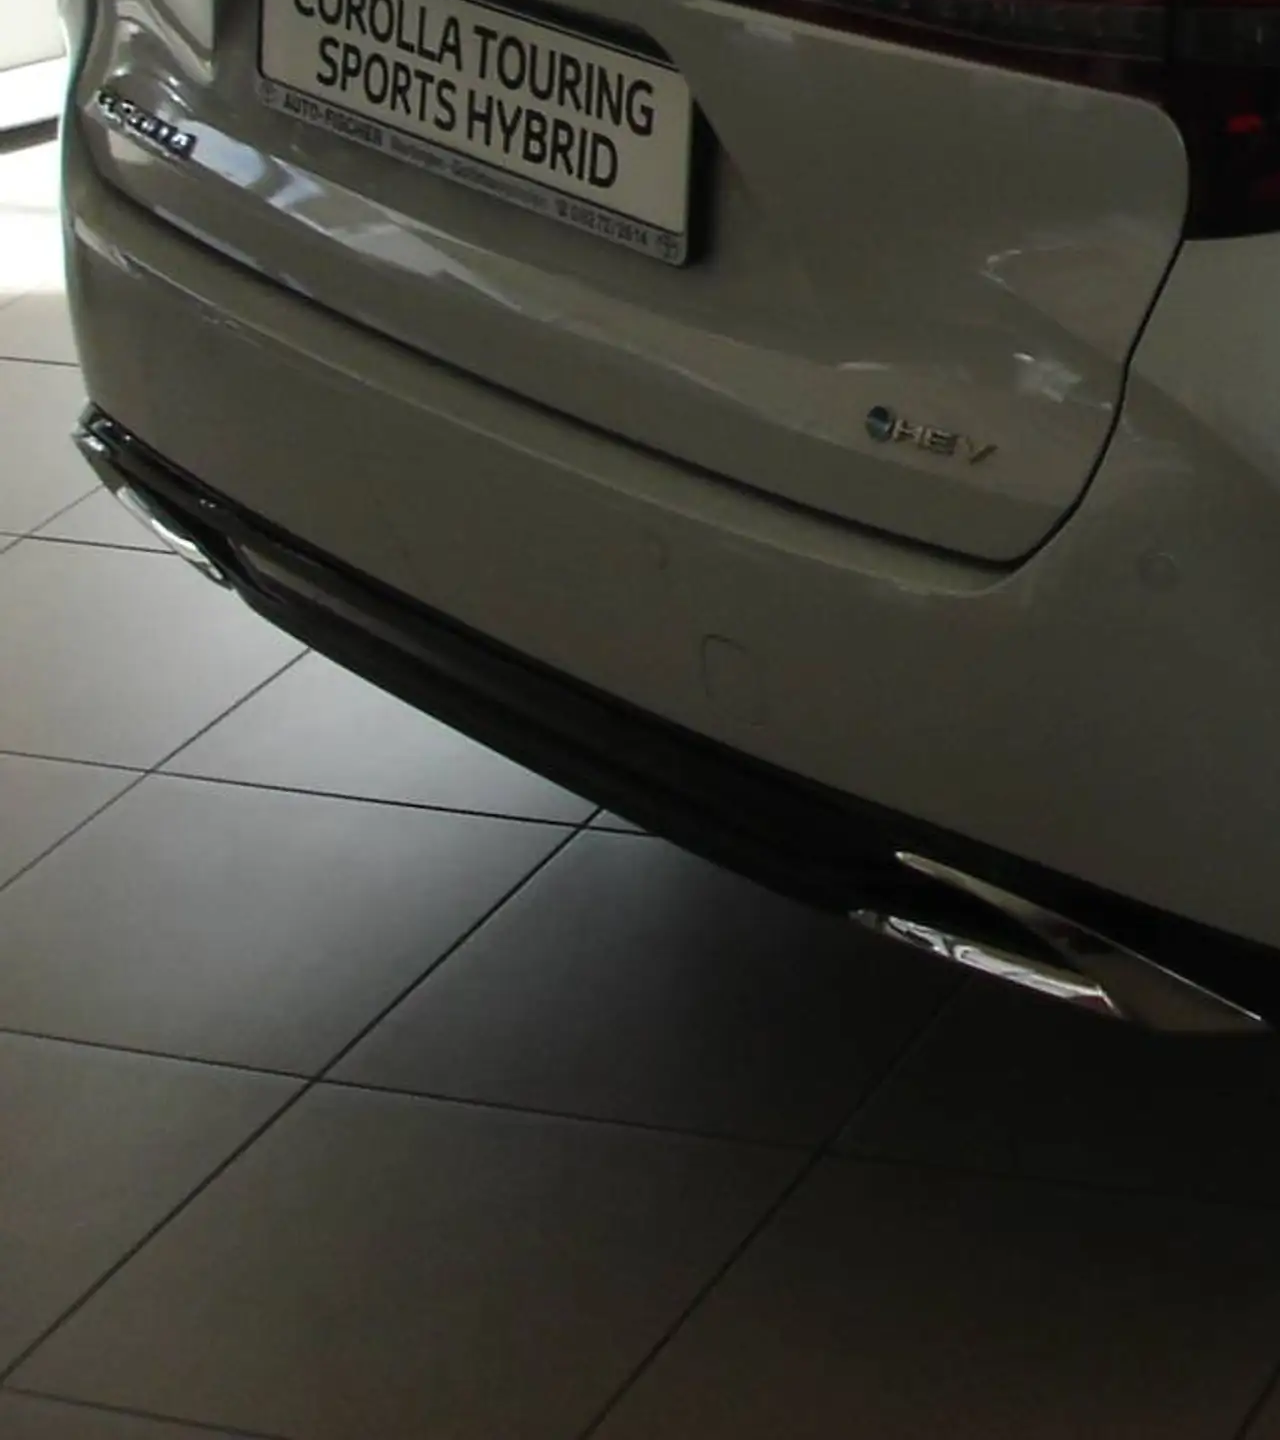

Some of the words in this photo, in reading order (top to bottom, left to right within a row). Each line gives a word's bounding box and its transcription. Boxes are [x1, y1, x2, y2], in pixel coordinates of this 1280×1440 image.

[316, 36, 458, 133] SPORTS
[466, 86, 619, 190] HYBRID
[473, 24, 656, 138] TOURING
[892, 418, 999, 466] HEV
